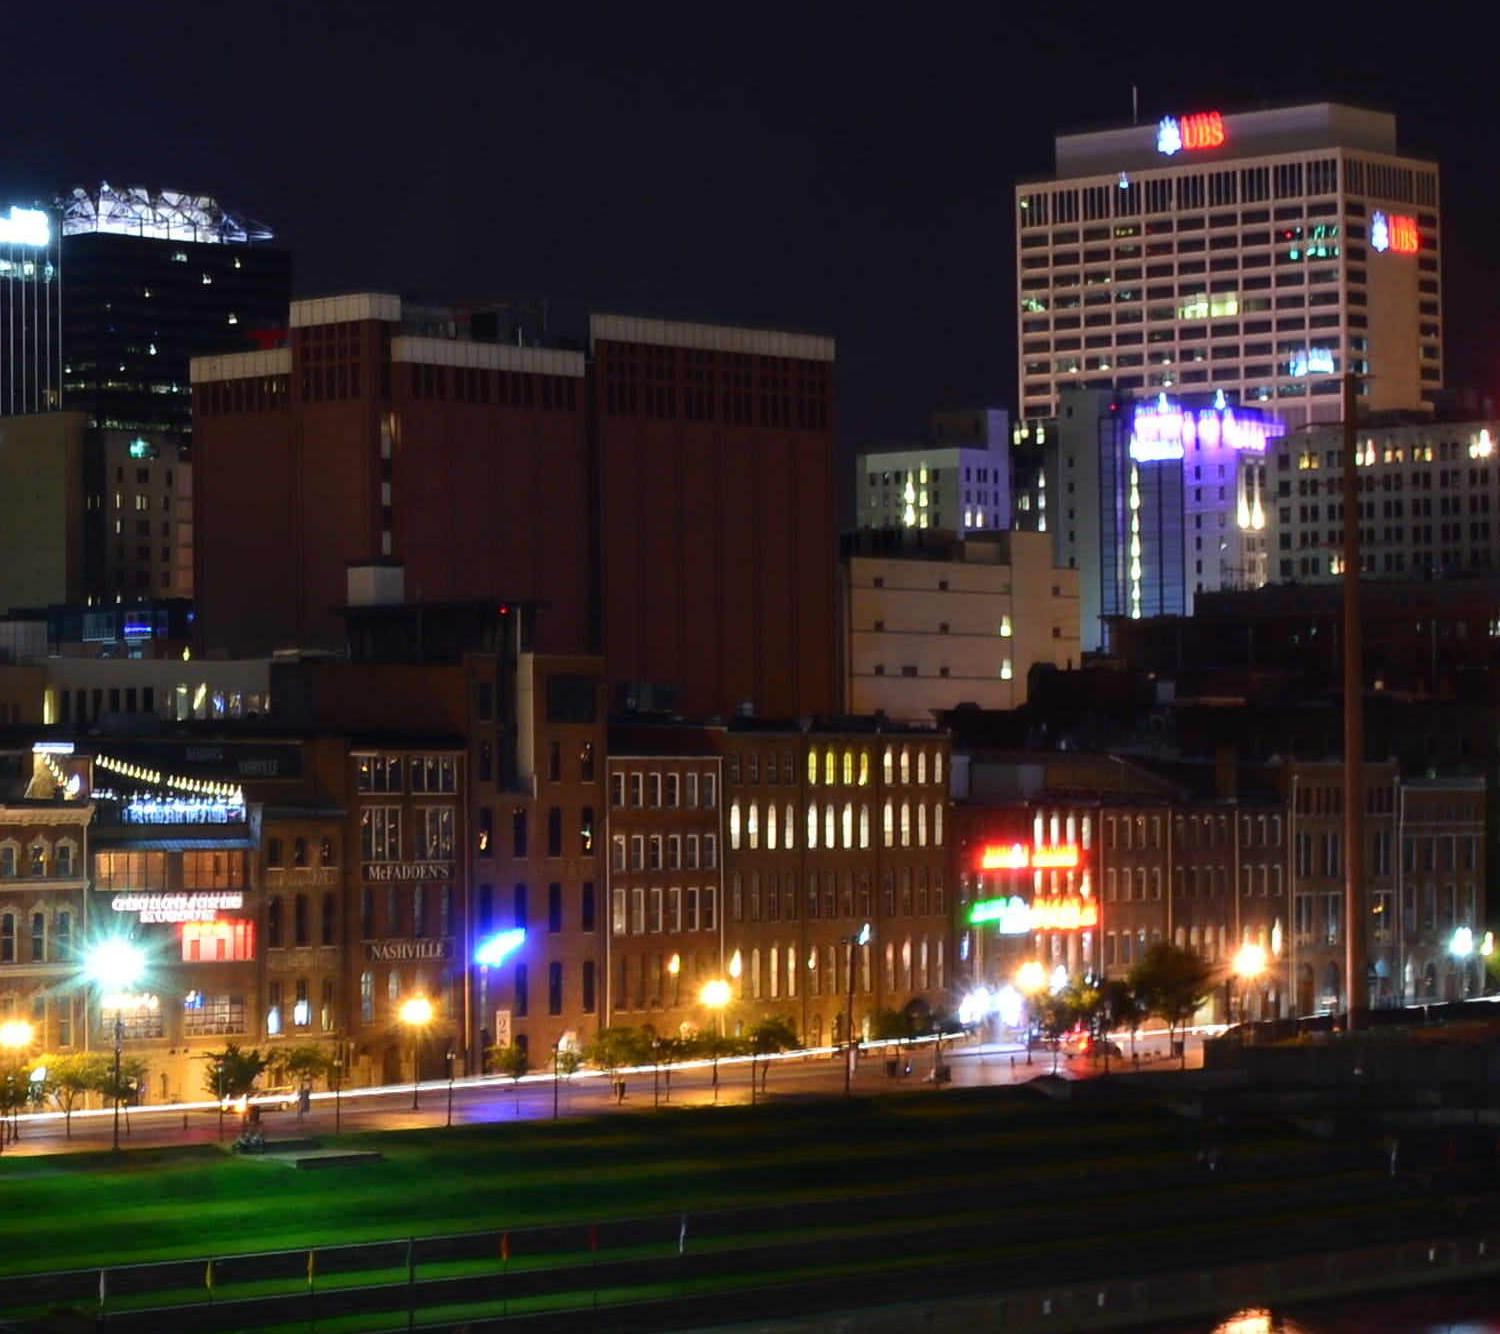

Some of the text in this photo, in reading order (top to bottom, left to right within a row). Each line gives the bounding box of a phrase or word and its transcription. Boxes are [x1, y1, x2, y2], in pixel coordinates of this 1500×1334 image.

[1180, 112, 1225, 150] UBS
[1389, 215, 1418, 253] UBS
[368, 864, 449, 880] McFADDEN'S
[371, 943, 444, 960] NASHVILLE
